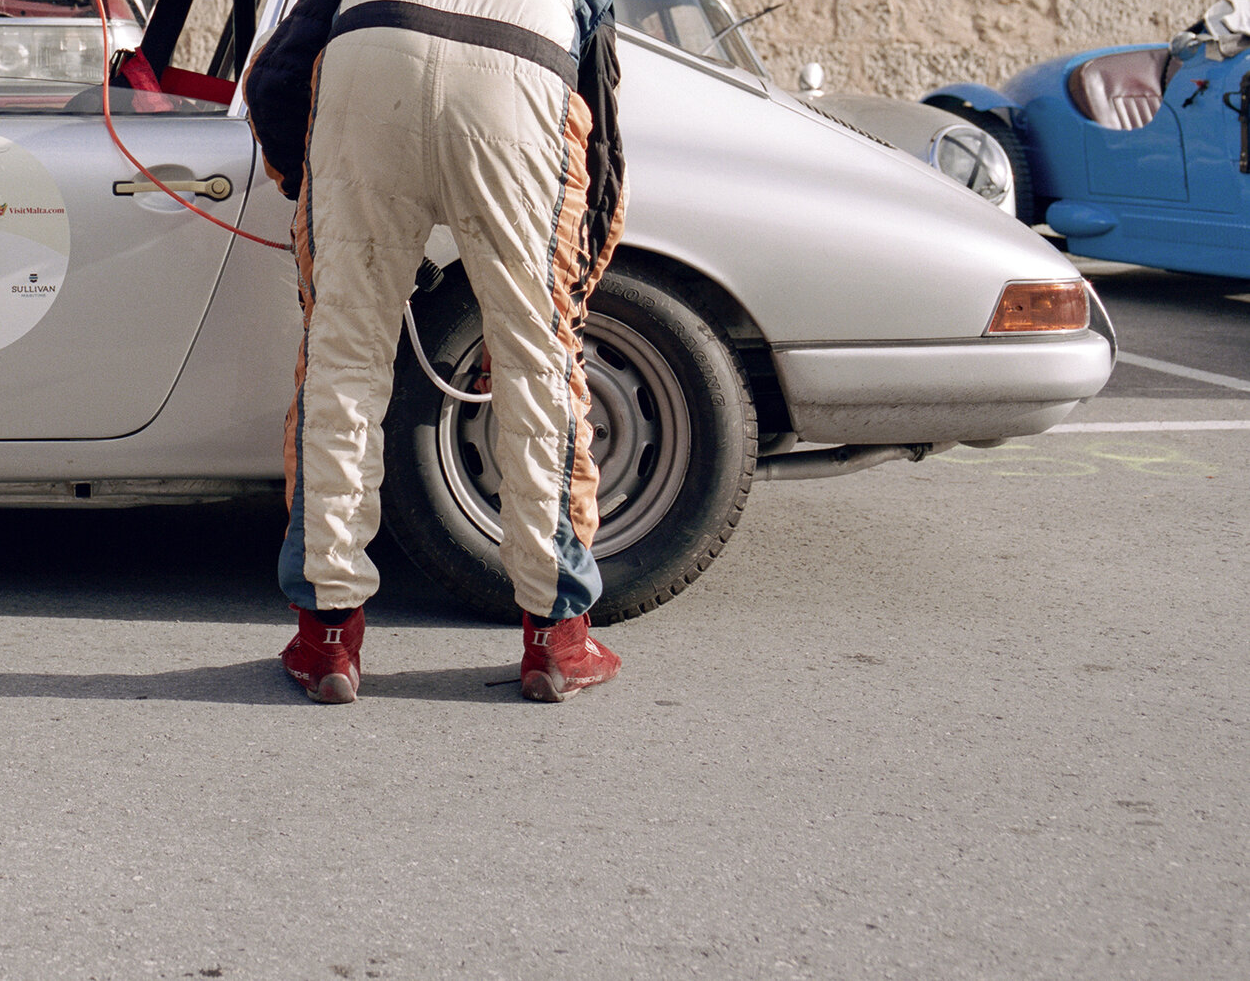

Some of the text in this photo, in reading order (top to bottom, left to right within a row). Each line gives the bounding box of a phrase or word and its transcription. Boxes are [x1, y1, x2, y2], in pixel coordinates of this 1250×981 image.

[9, 207, 65, 215] VisitMalta.com
[12, 285, 56, 293] SULLIVAN
[597, 277, 657, 310] NLOP
